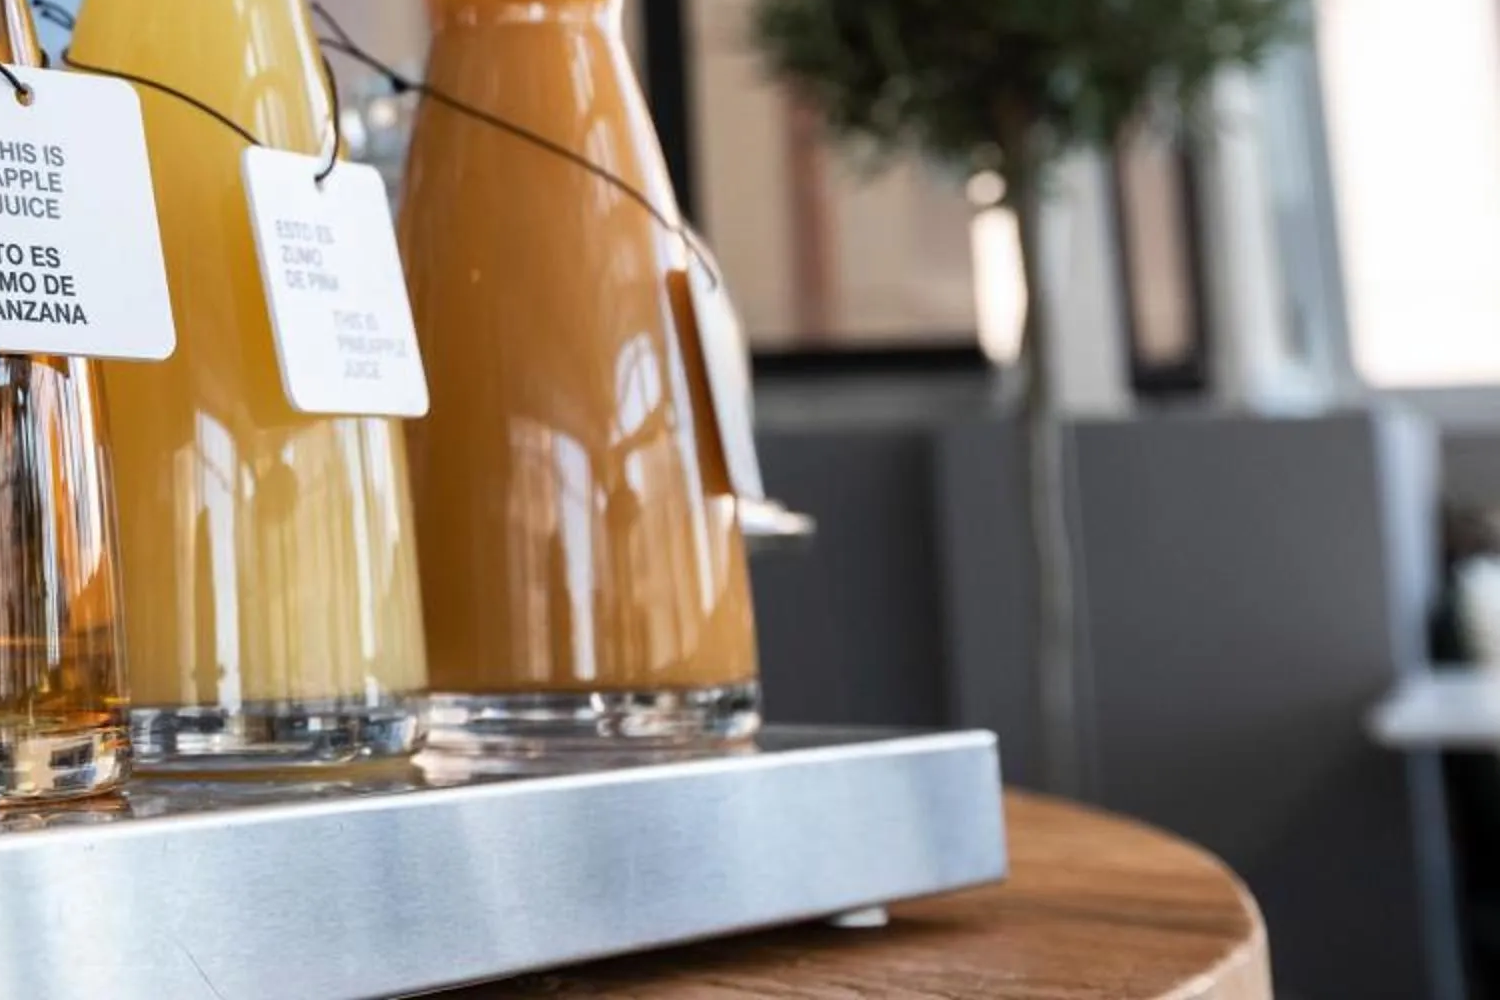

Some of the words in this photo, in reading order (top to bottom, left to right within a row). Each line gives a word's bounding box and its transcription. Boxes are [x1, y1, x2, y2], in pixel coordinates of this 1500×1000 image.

[43, 145, 65, 167] IS
[31, 246, 61, 268] ES
[43, 275, 77, 297] DE
